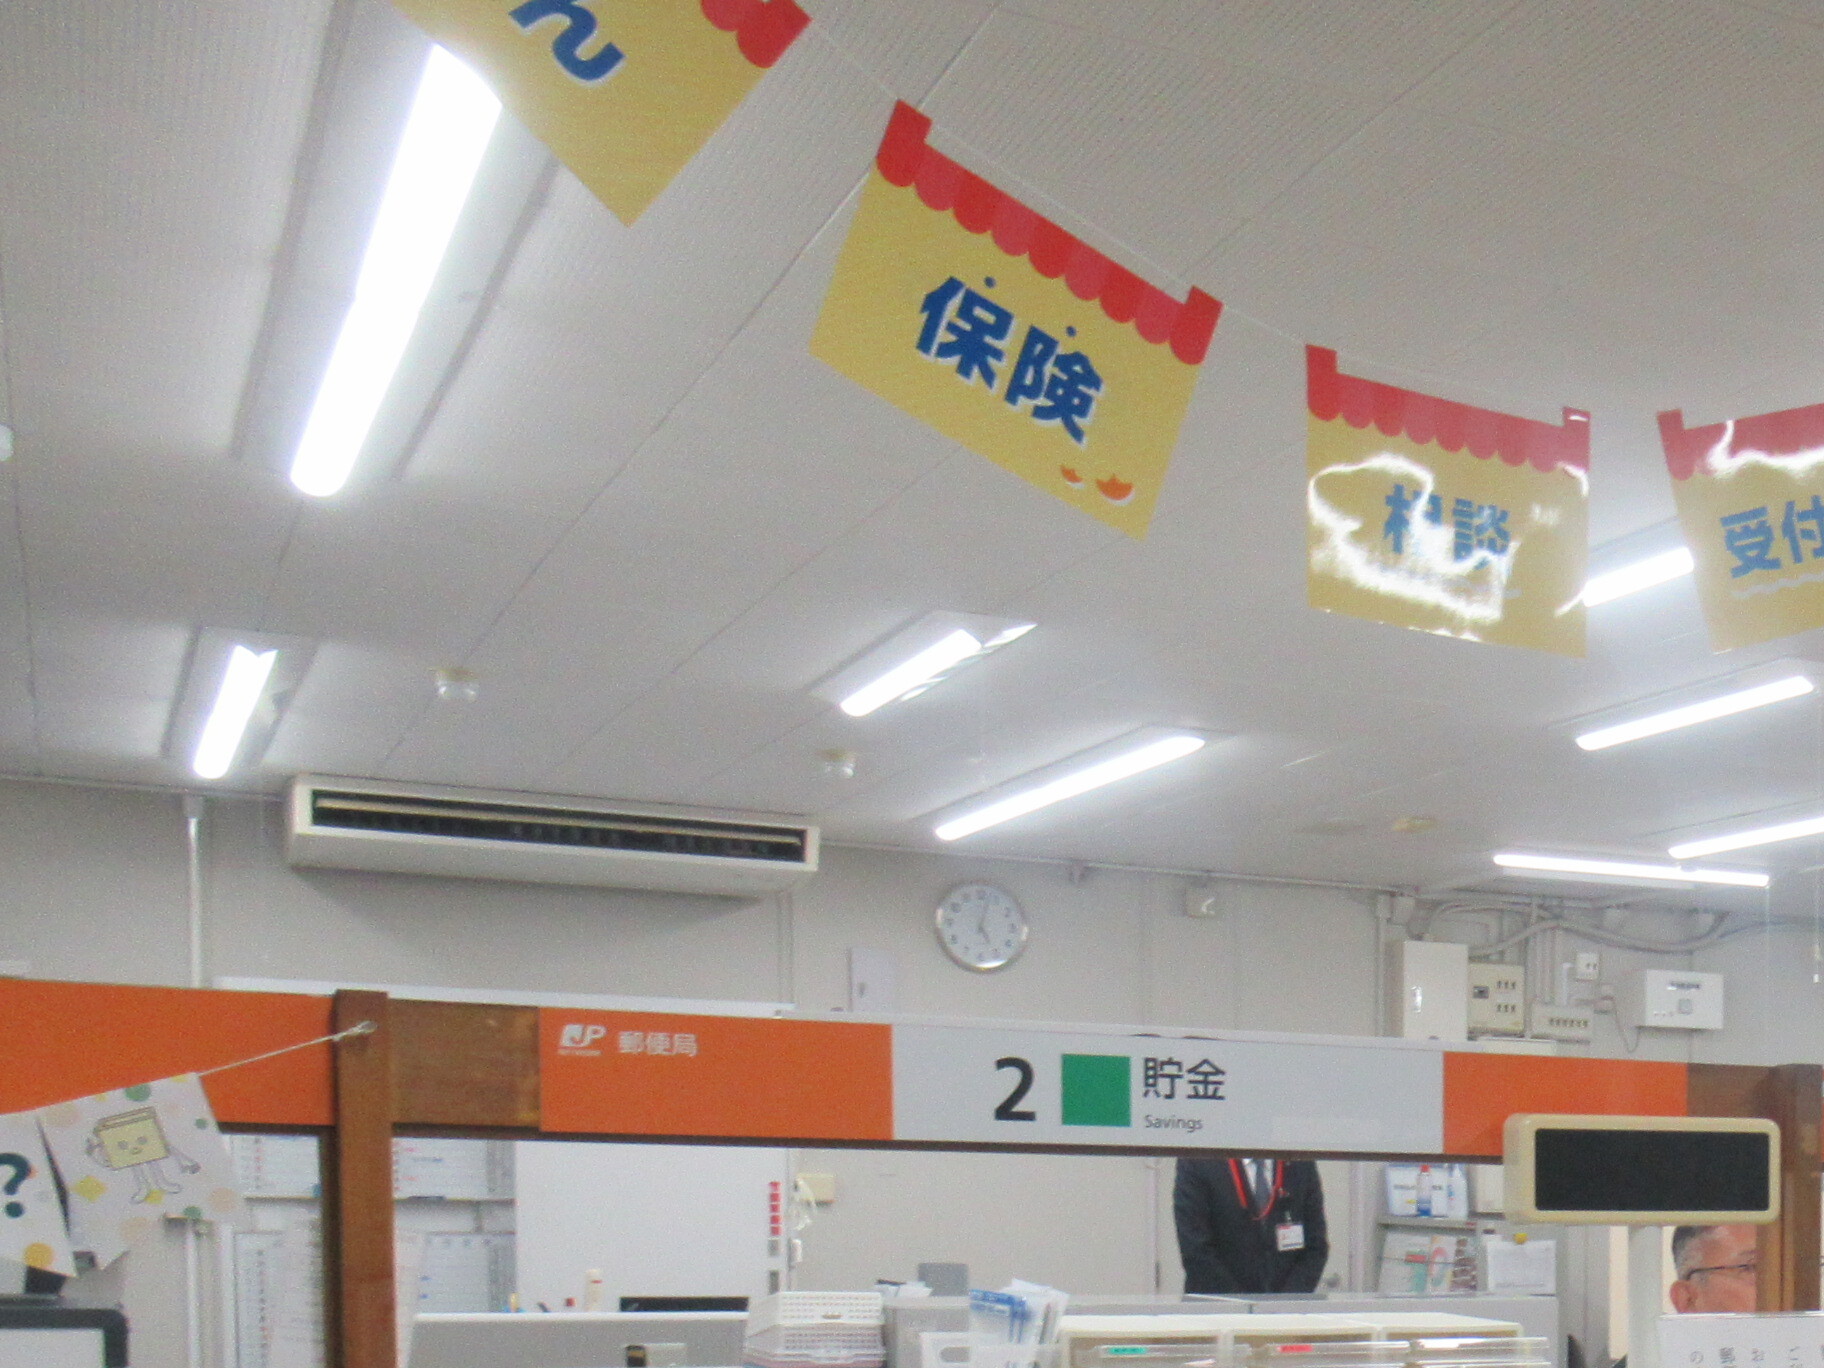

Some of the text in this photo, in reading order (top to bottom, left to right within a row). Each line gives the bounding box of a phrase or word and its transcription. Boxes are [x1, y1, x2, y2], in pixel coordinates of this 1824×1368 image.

[915, 275, 1104, 446] 保険
[1383, 483, 1513, 573] 相談
[619, 1031, 698, 1057] 郵便局
[993, 1056, 1038, 1122] 2
[1143, 1056, 1227, 1102] 貯金
[1144, 1114, 1204, 1134] Savings
